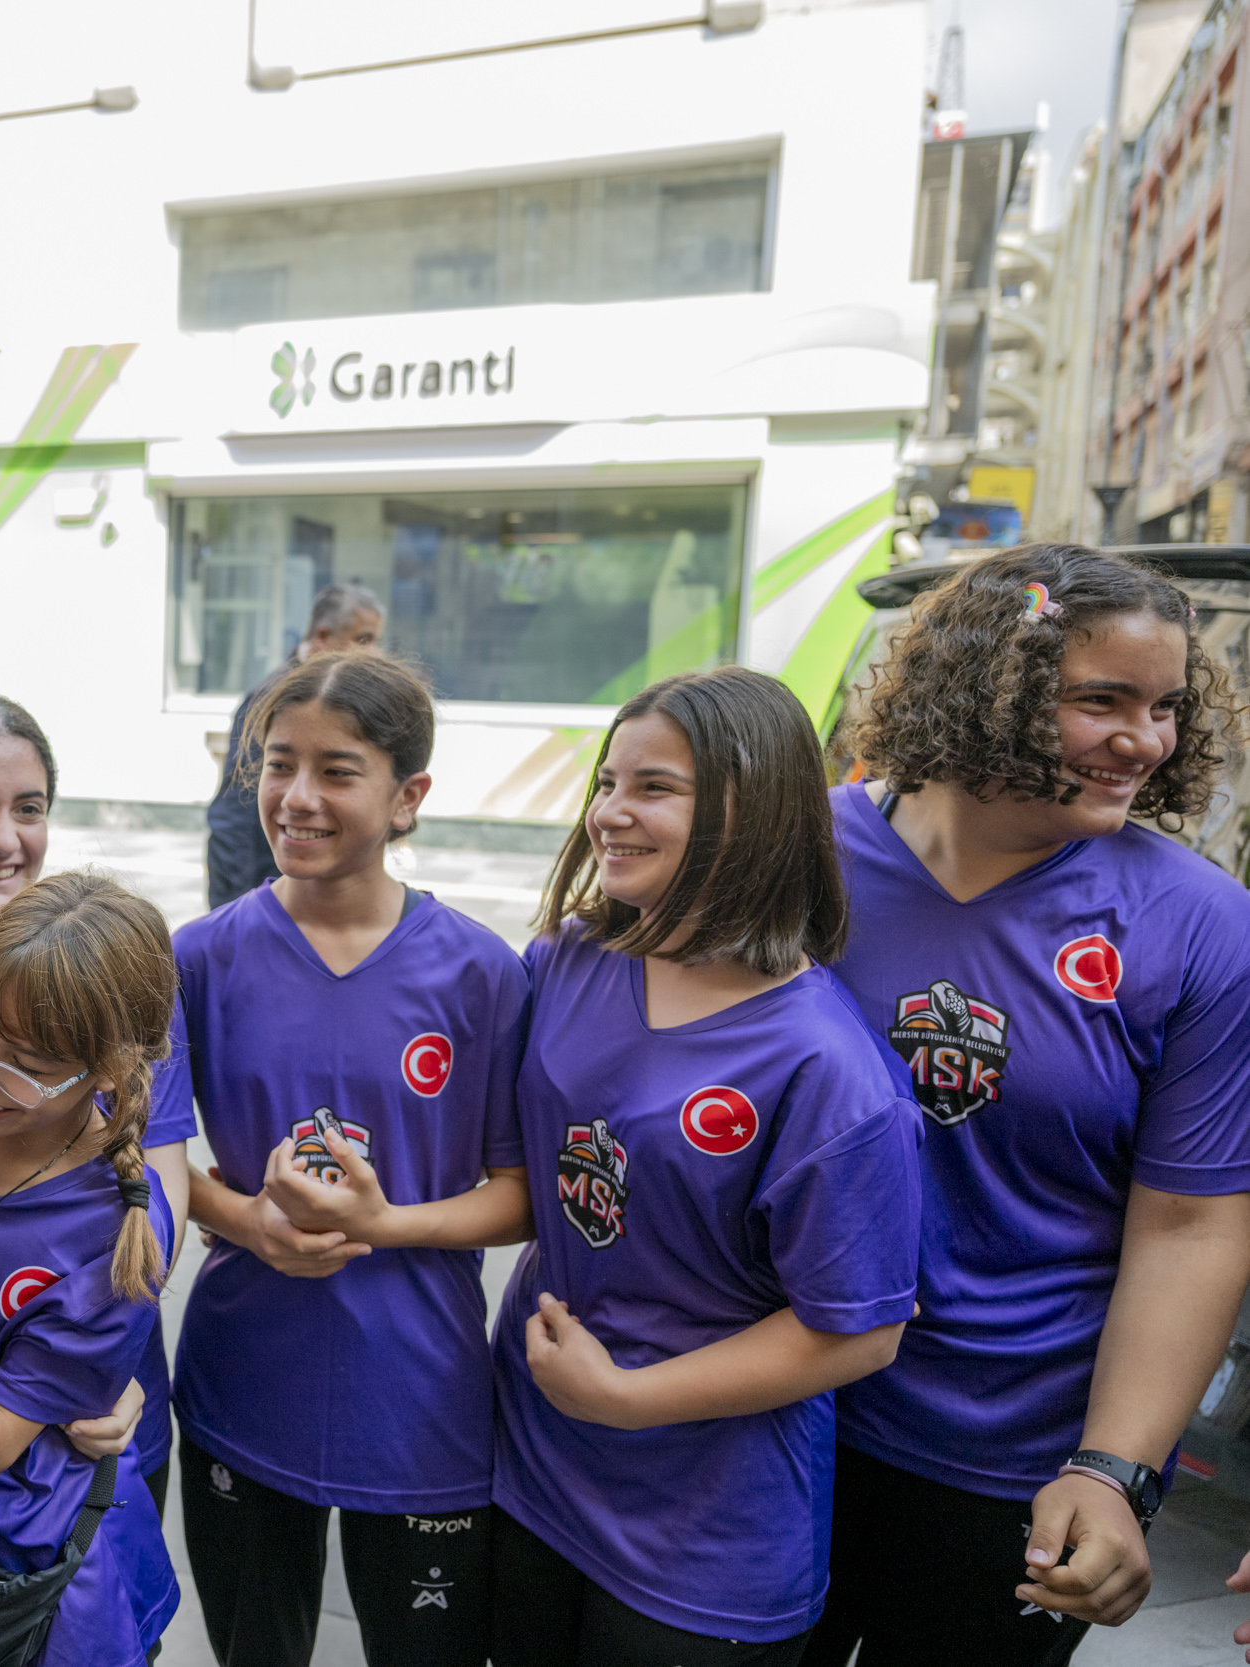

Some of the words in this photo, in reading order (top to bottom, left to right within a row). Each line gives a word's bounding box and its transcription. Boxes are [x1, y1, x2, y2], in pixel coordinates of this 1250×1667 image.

[891, 1030, 920, 1039] MERSİN
[921, 1031, 965, 1046] BÜYÜKŞEHİR
[966, 1039, 1006, 1058] BELEDİYESİ
[558, 1172, 624, 1236] MSK
[405, 1514, 472, 1534] TRYON
